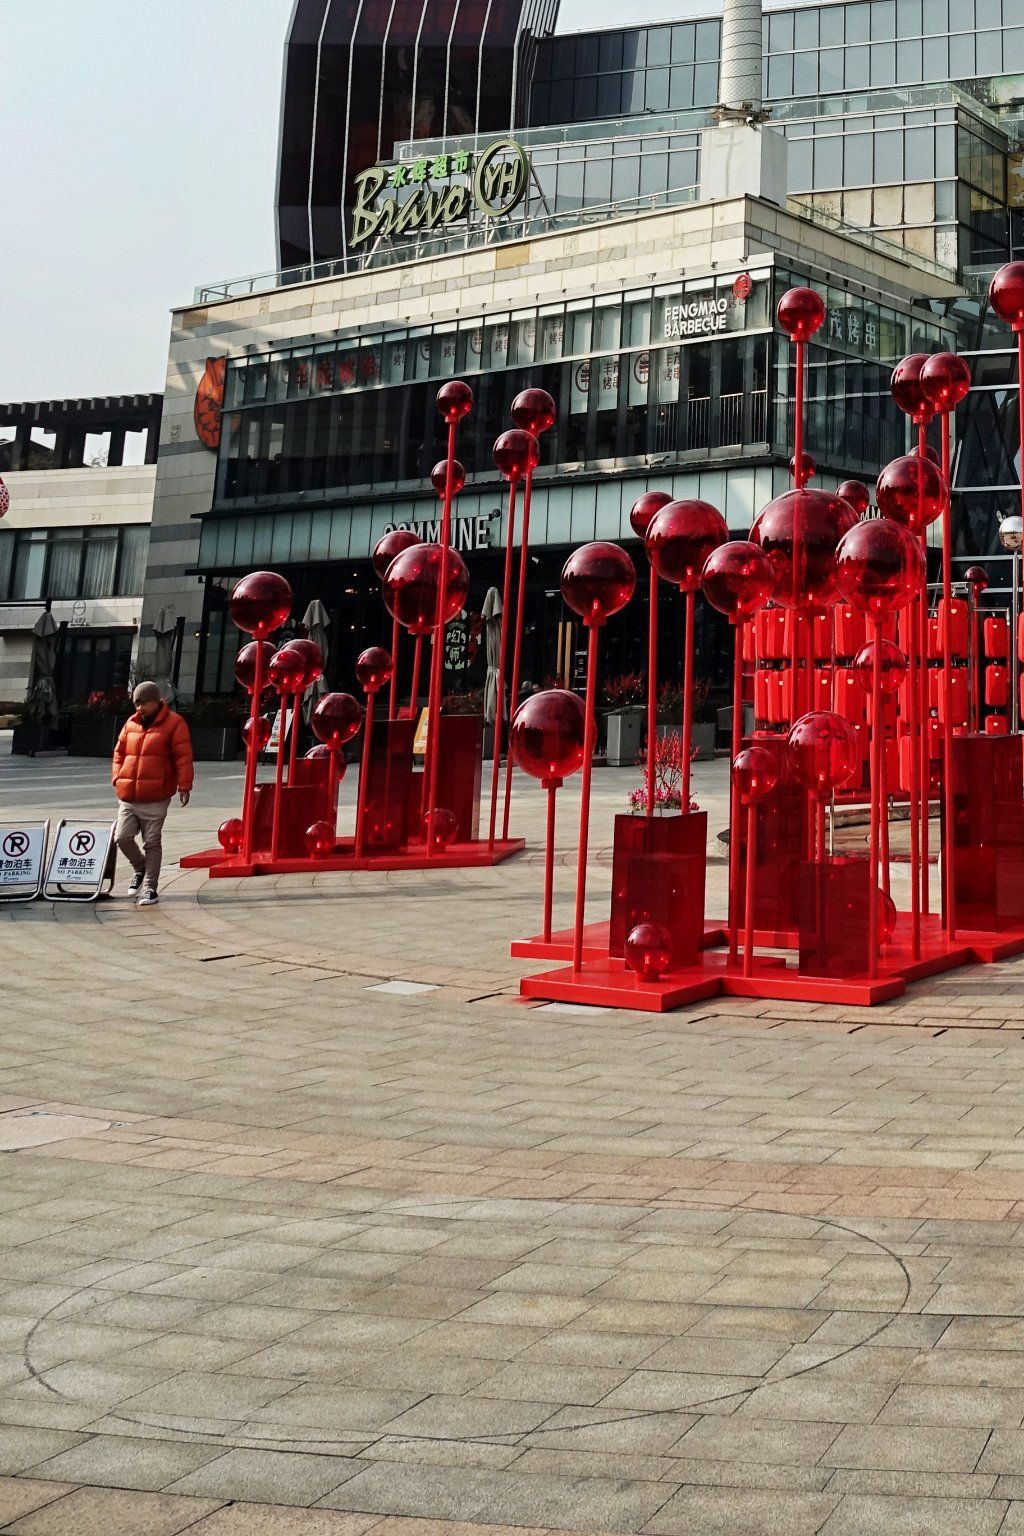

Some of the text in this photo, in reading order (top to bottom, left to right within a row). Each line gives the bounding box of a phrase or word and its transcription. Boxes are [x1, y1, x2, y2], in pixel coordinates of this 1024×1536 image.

[391, 150, 470, 188] 永辉超市
[349, 159, 521, 248] Bravo YH
[664, 298, 728, 321] FENGMAO
[664, 315, 727, 338] BARBECUE
[59, 857, 96, 867] 请勿泊车
